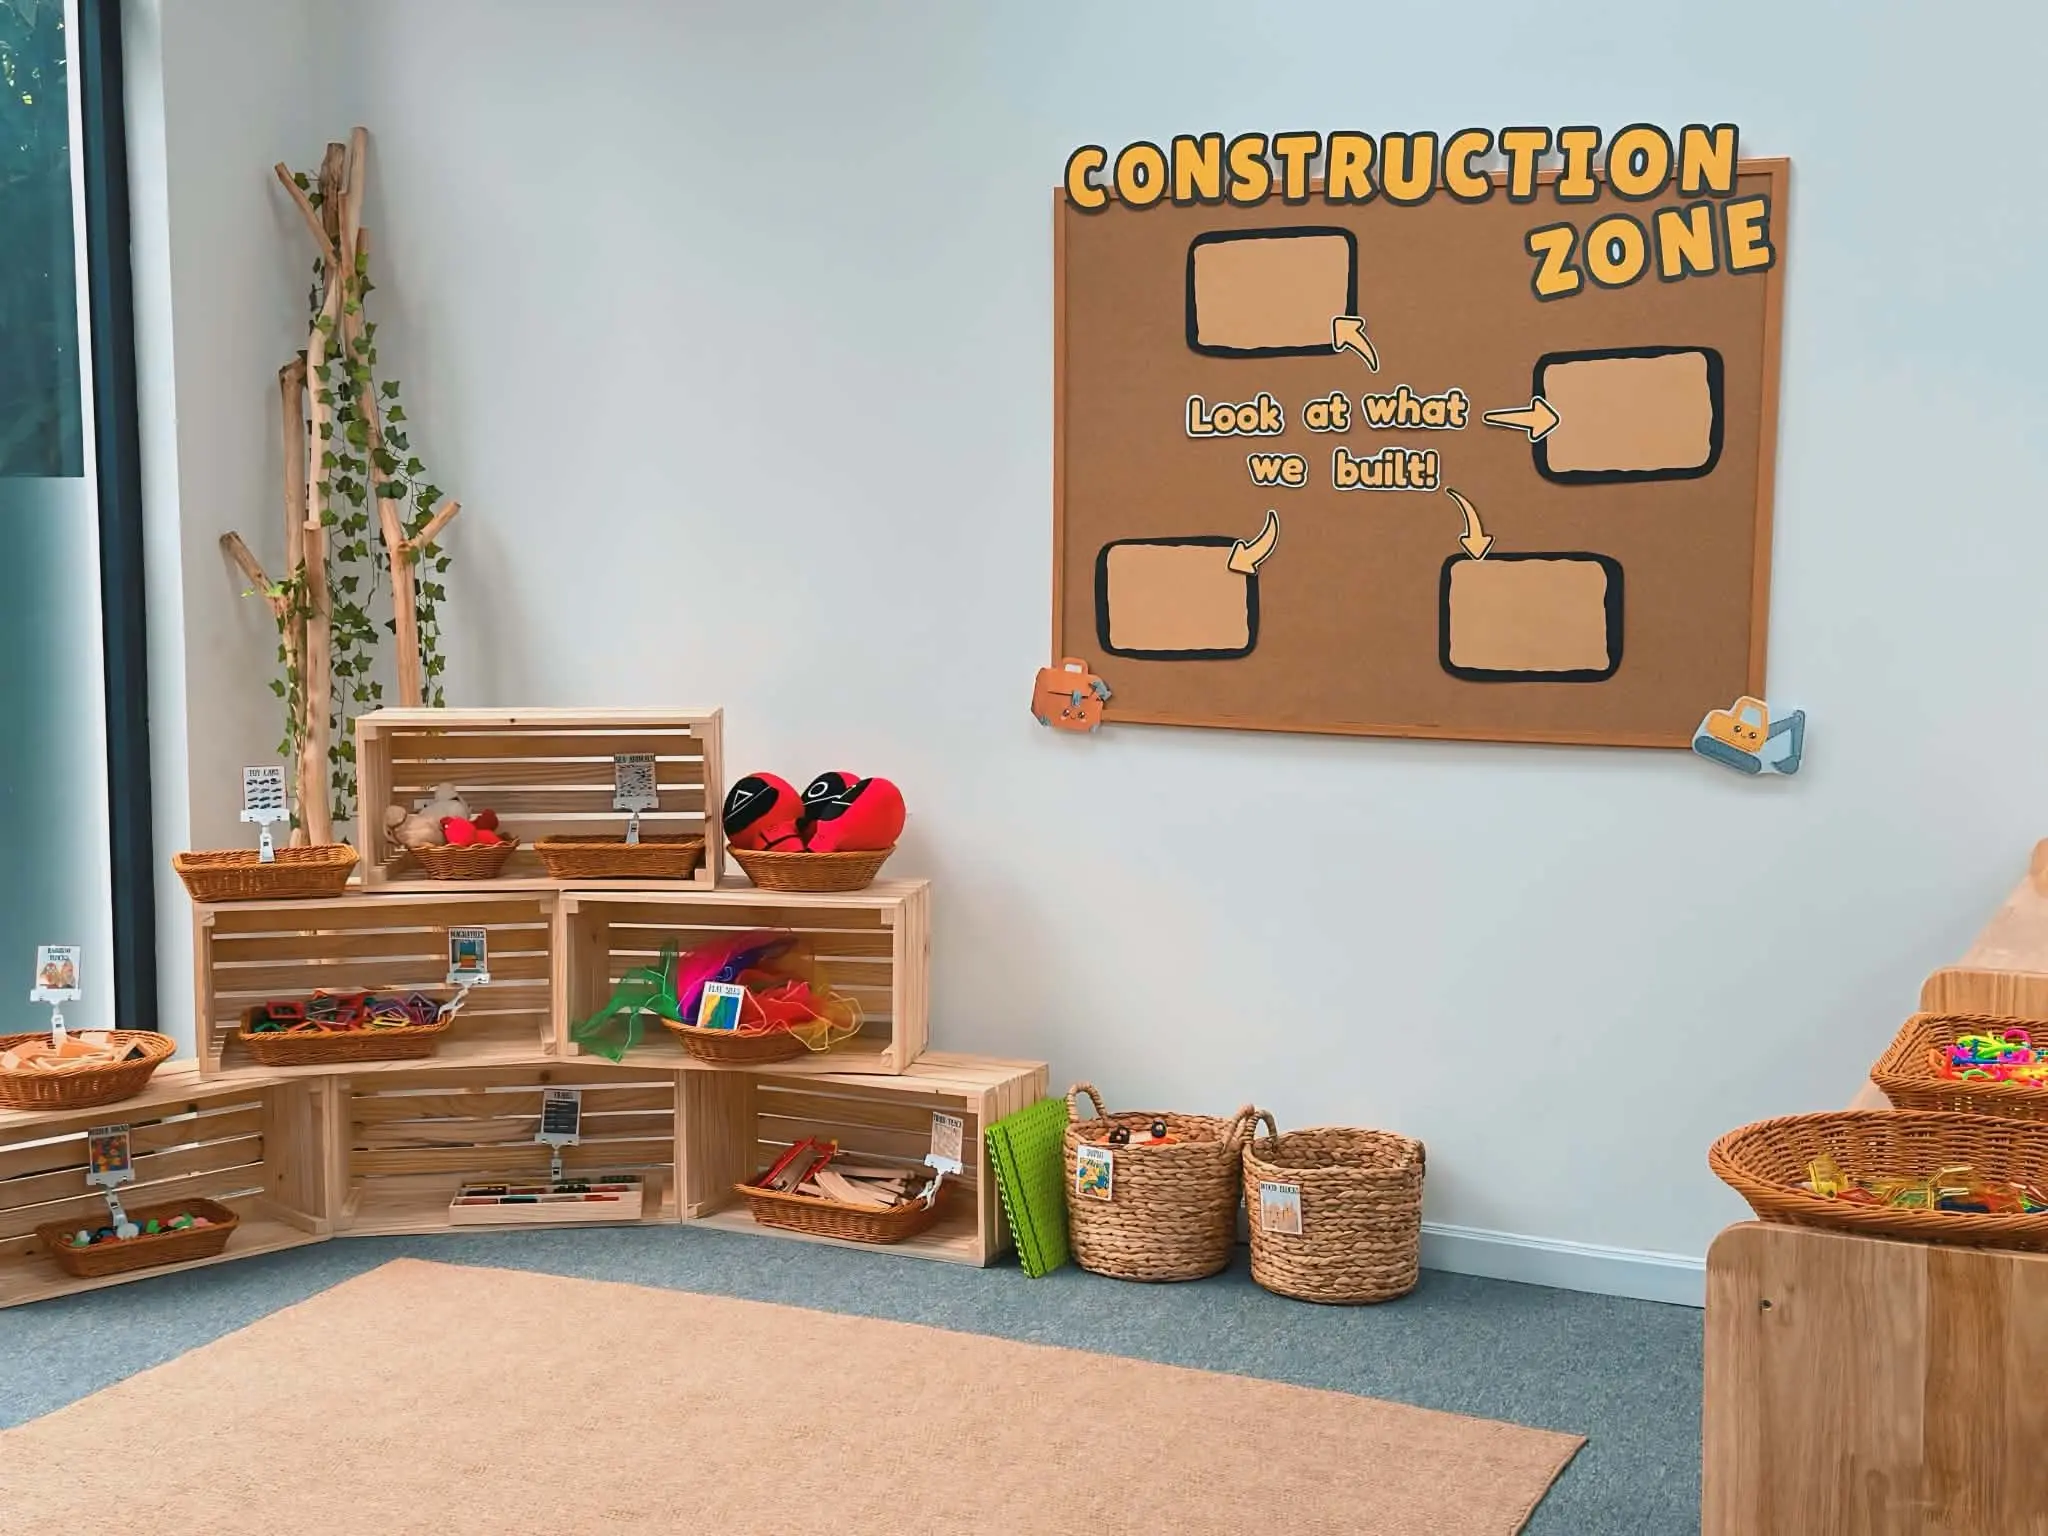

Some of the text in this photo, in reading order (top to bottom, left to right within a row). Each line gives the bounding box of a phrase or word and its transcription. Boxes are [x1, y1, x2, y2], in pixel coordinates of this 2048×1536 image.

[1066, 122, 1738, 210] CONSTRUCTION
[1527, 195, 1777, 302] ZONE
[1188, 385, 1469, 436] Look at what
[1248, 447, 1439, 491] we built!
[248, 768, 279, 777] TOY CARS
